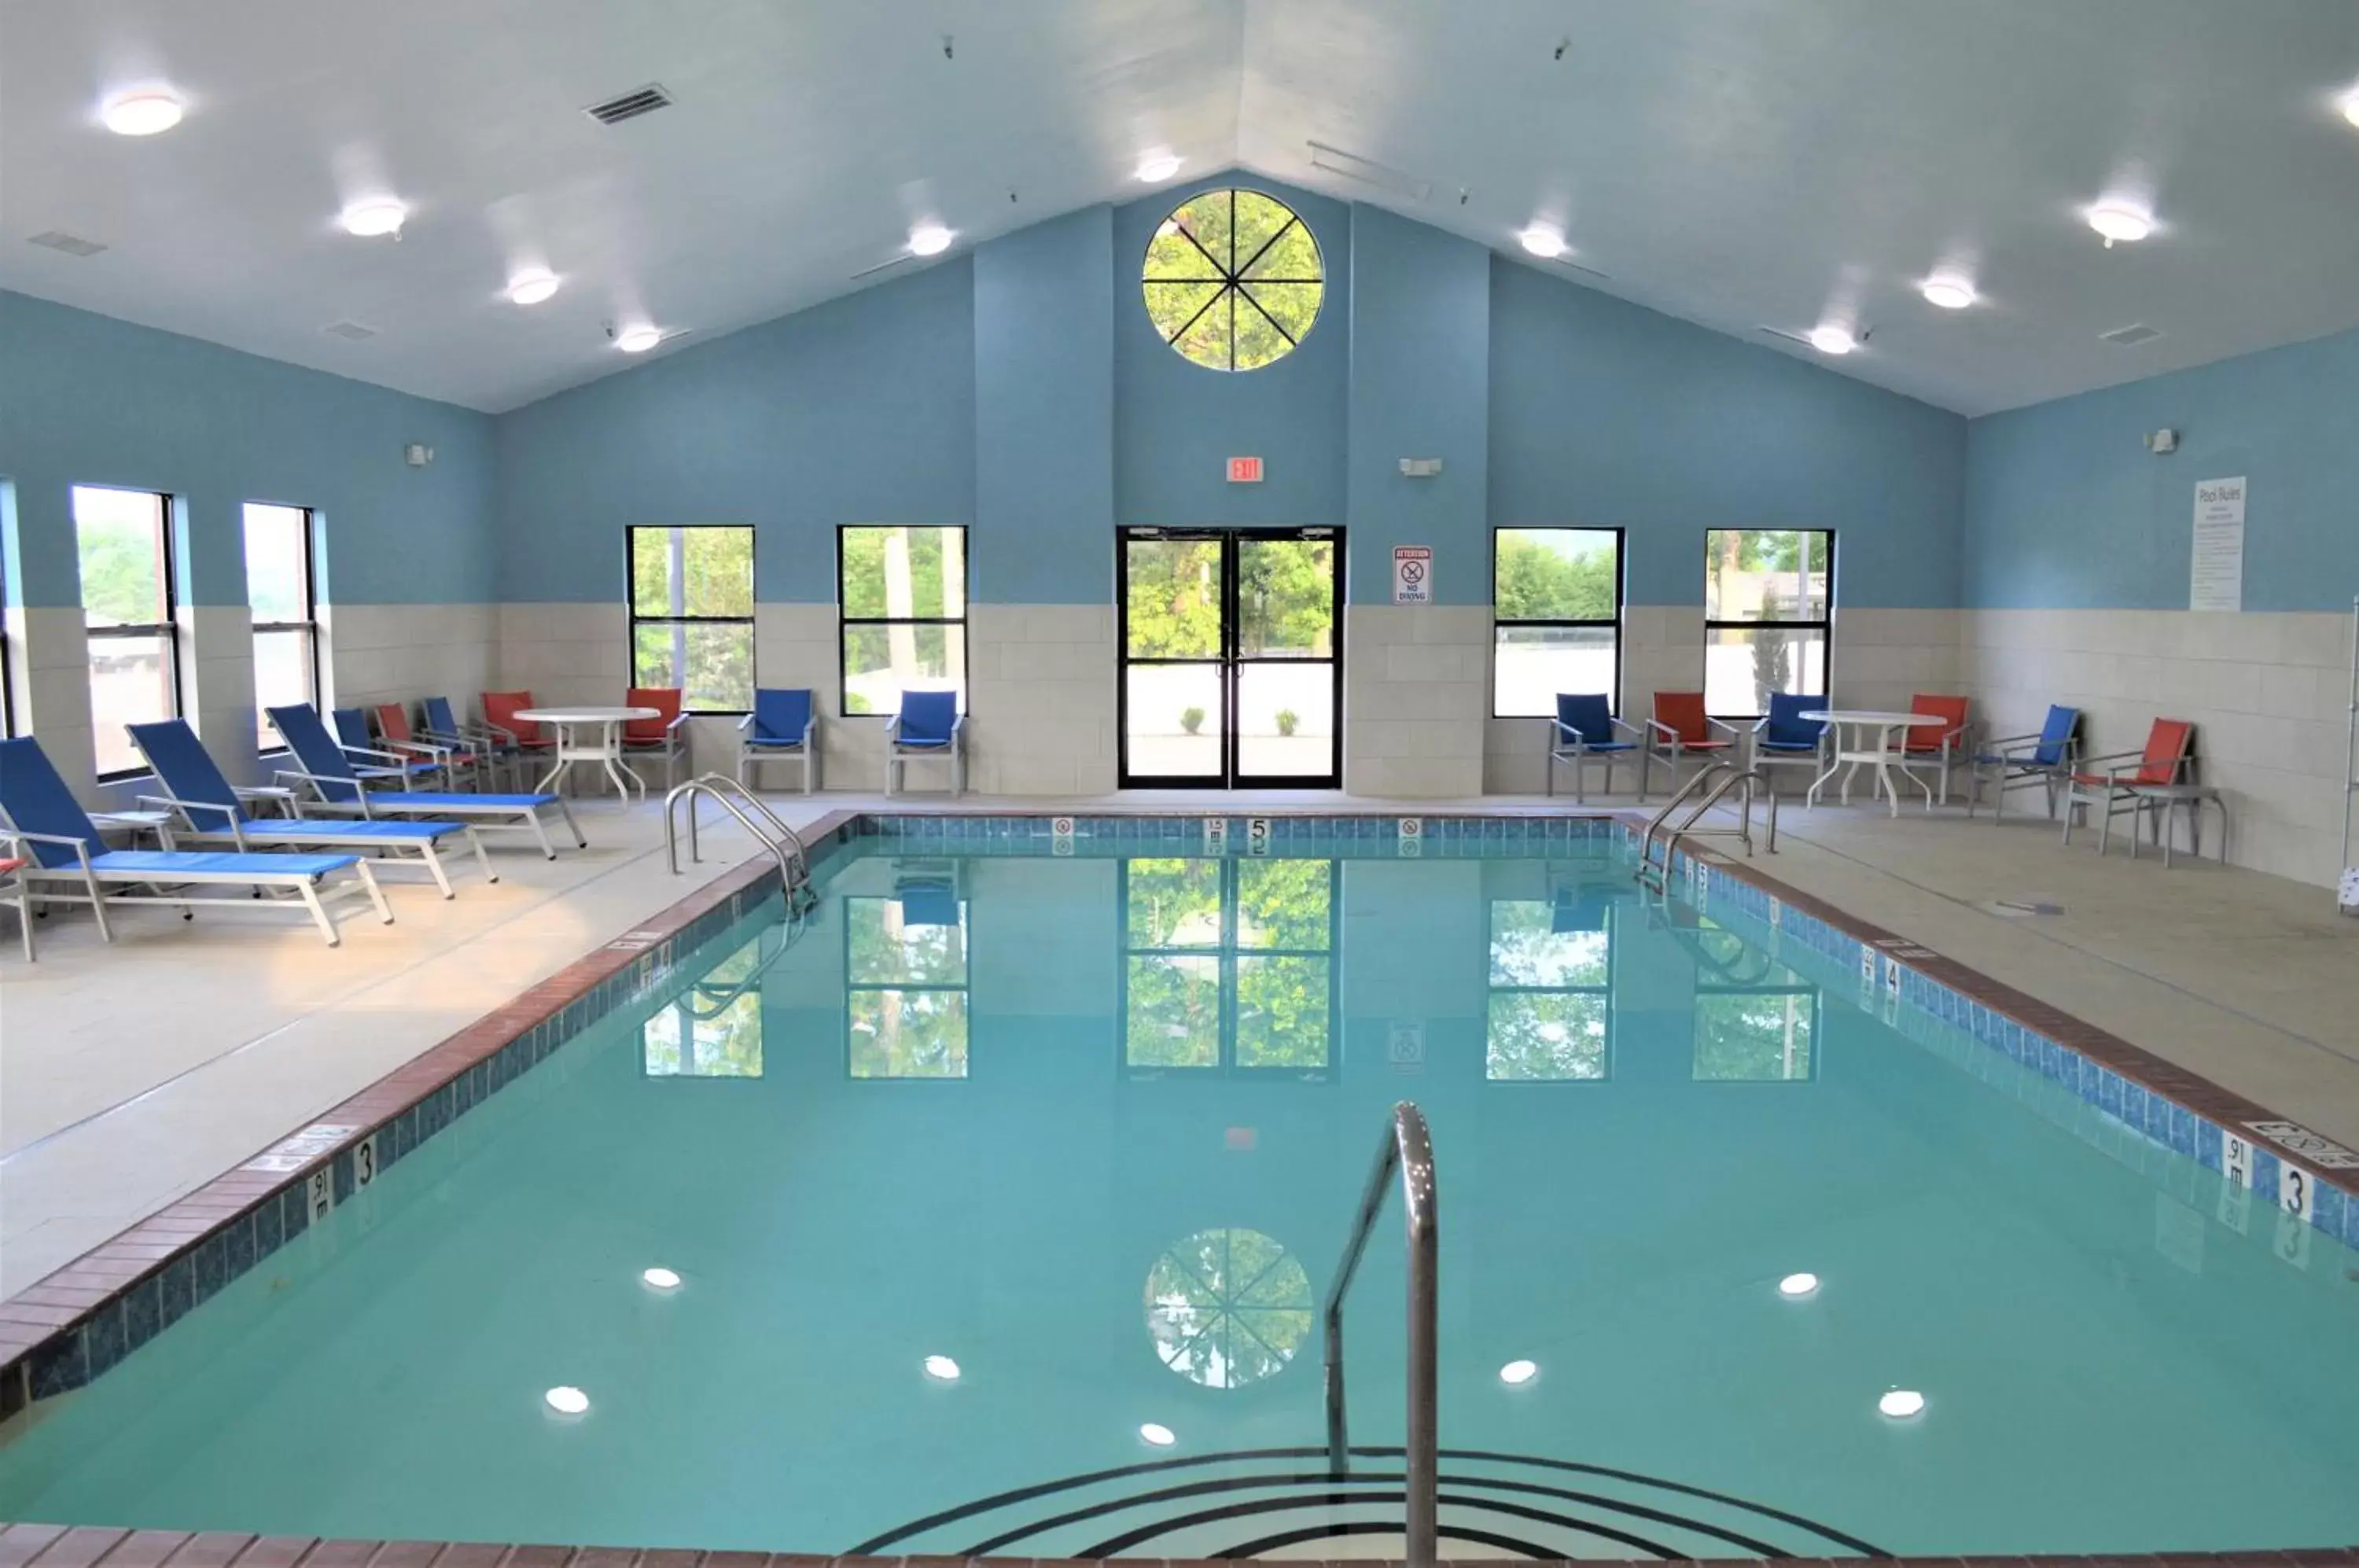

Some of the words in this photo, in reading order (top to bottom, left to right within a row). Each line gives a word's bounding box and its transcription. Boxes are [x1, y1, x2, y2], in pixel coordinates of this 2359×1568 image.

[1232, 459, 1258, 479] EXIT
[2199, 488, 2217, 502] Pool
[2219, 485, 2240, 502] Rules
[1252, 820, 1265, 838] 5
[359, 1142, 372, 1186] 3
[2287, 1170, 2303, 1215] 3
